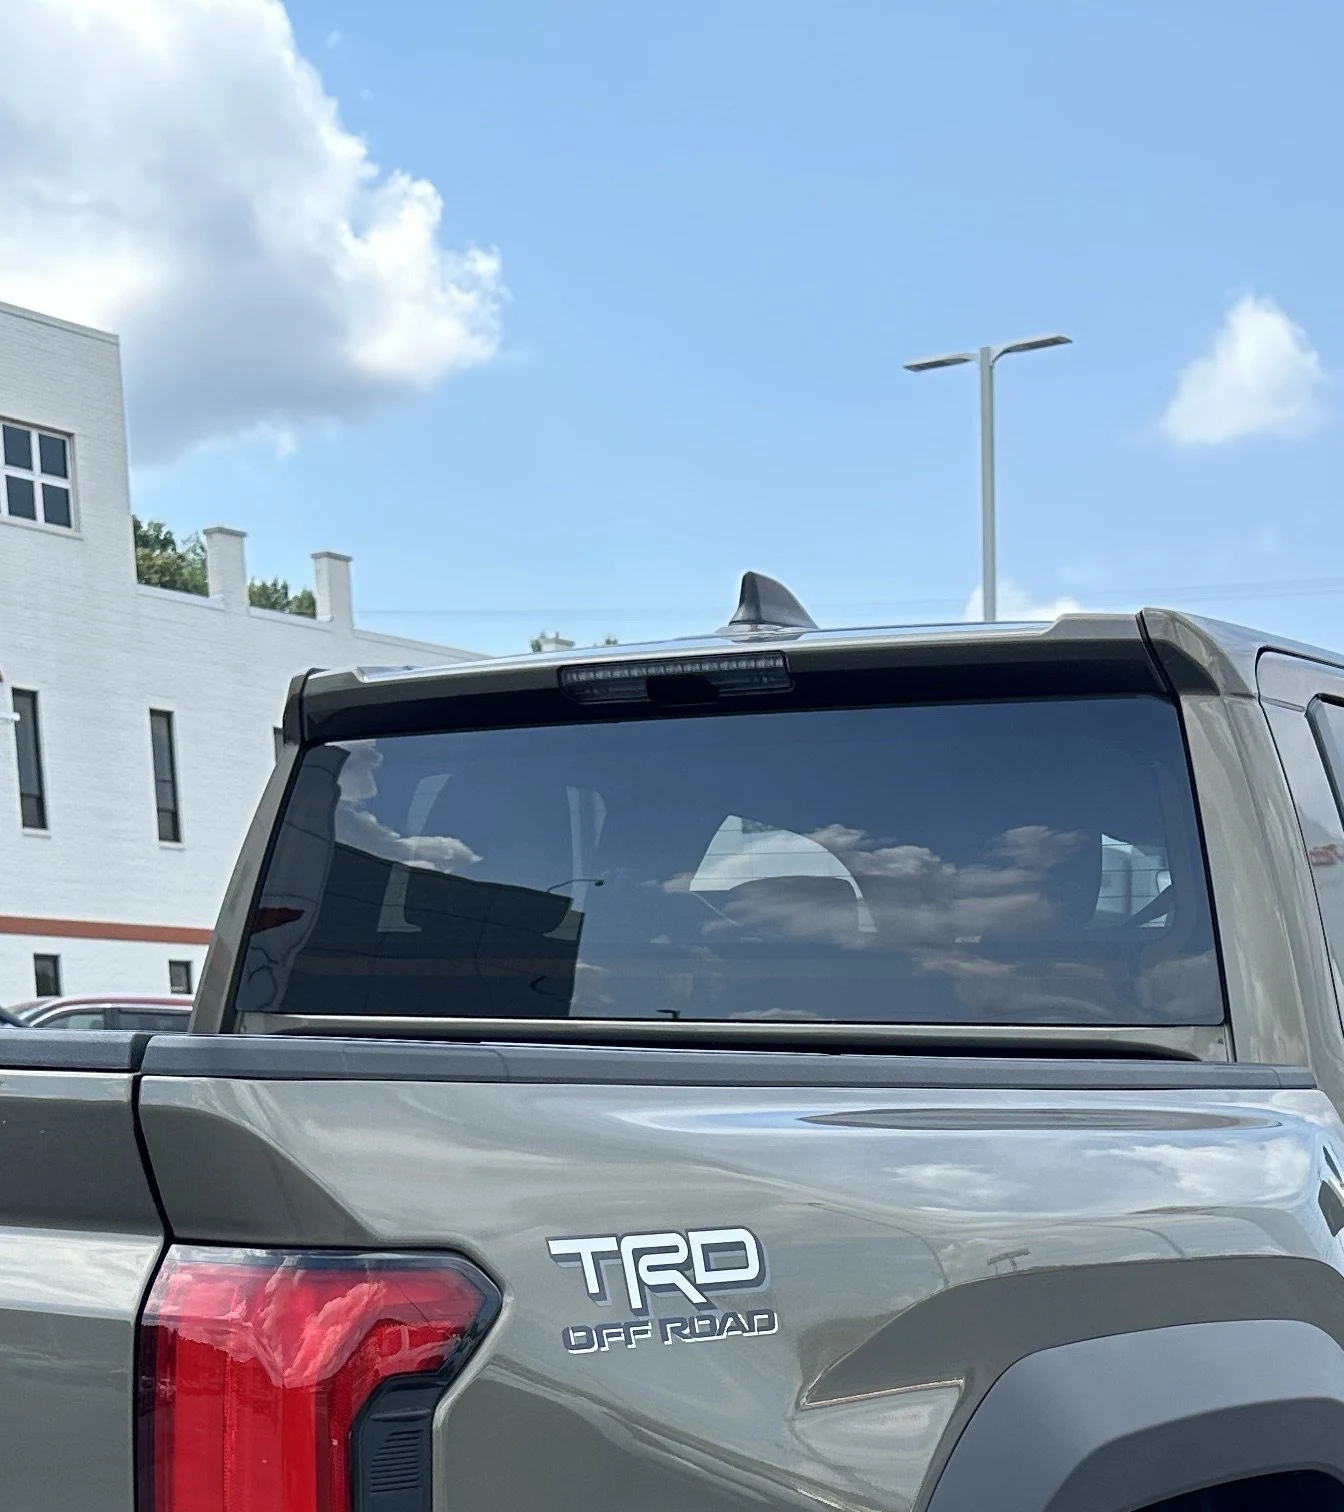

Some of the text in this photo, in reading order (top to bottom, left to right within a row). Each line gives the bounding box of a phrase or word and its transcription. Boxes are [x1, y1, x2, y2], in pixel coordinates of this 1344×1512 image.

[545, 1225, 768, 1316] TRD
[561, 1309, 780, 1354] OFF ROAD
